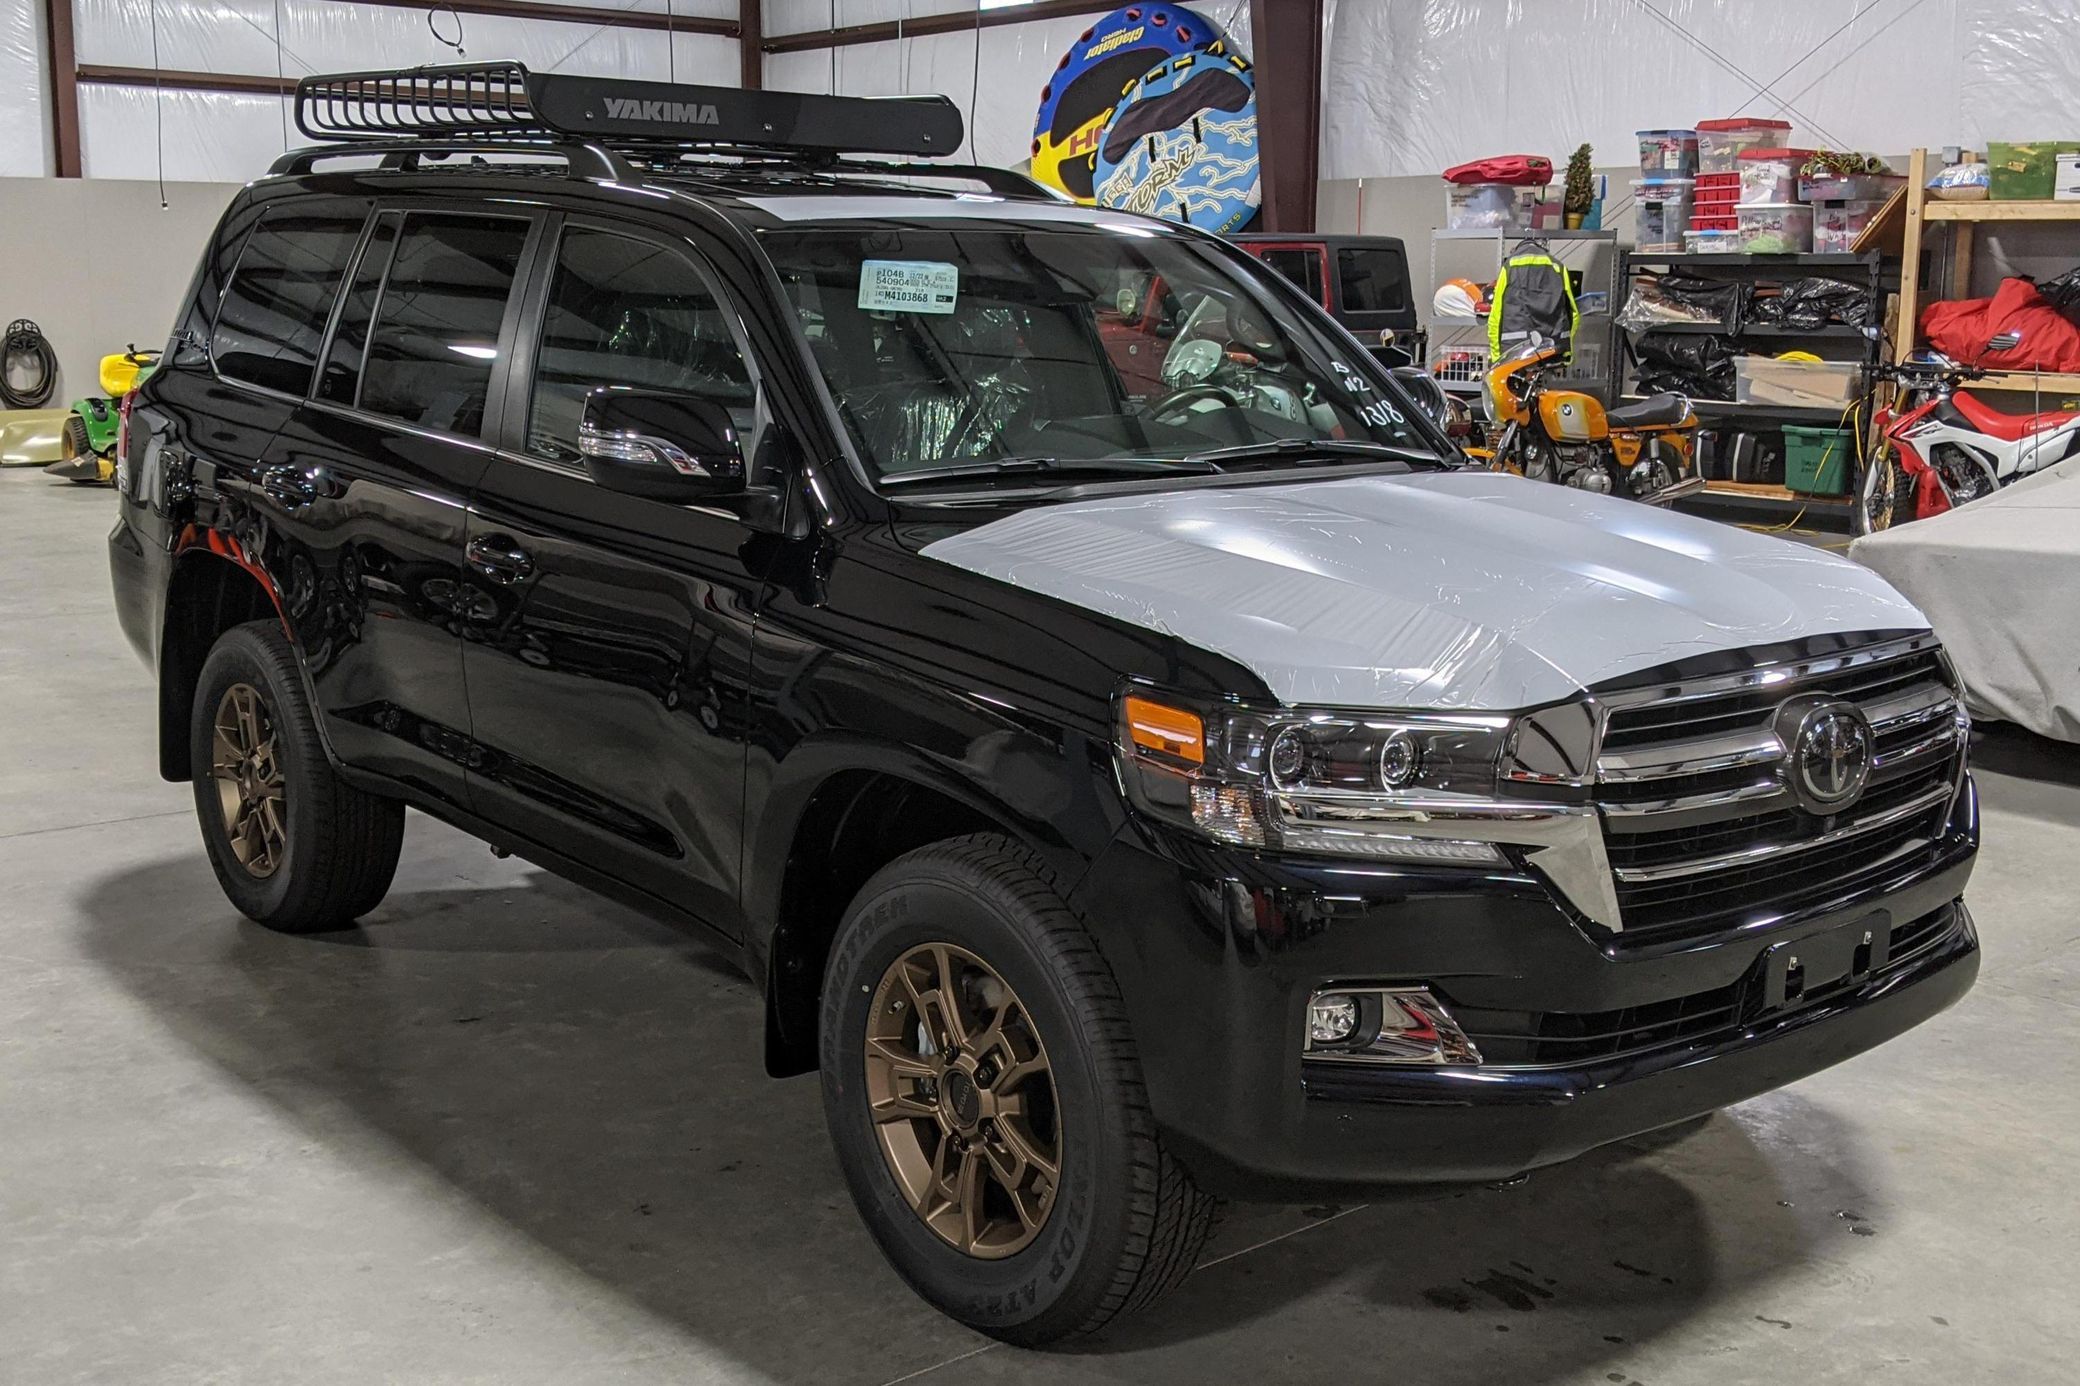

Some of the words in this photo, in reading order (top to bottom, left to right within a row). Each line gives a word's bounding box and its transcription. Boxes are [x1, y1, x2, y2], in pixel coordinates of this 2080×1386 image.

[1083, 26, 1144, 61] Gladiator
[603, 97, 719, 125] YAKIMA
[1122, 146, 1195, 213] TORM
[884, 290, 929, 303] M4103868
